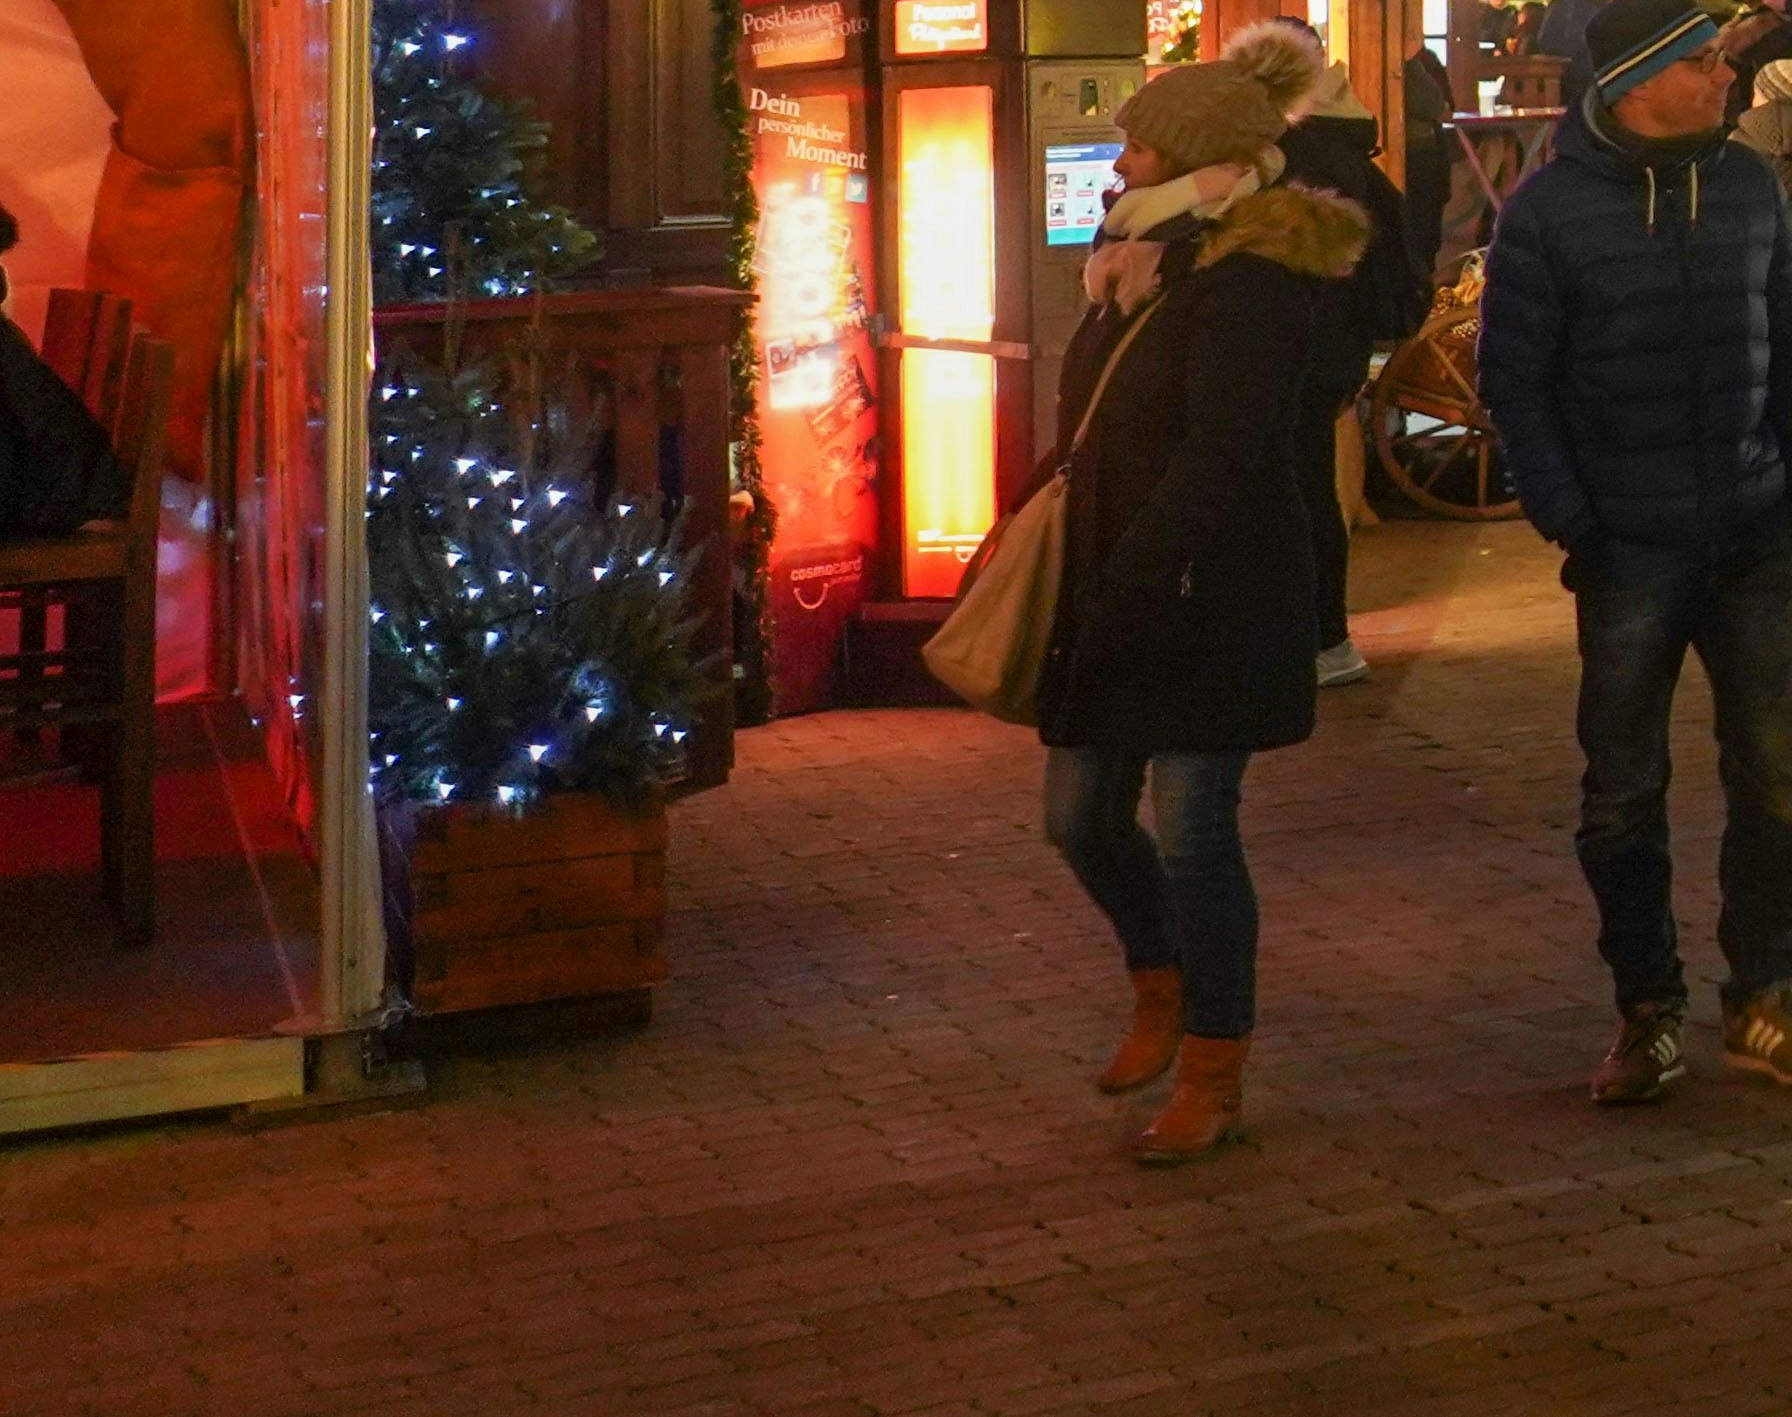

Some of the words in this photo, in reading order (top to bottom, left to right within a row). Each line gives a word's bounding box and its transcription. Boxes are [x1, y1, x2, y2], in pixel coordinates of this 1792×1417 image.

[741, 0, 843, 35] Postkarten
[751, 36, 776, 56] mit
[829, 16, 869, 38] Foto
[750, 87, 800, 118] Dein
[758, 116, 846, 144] persönlicher
[786, 136, 868, 170] Moment
[790, 555, 863, 582] cosmocard
